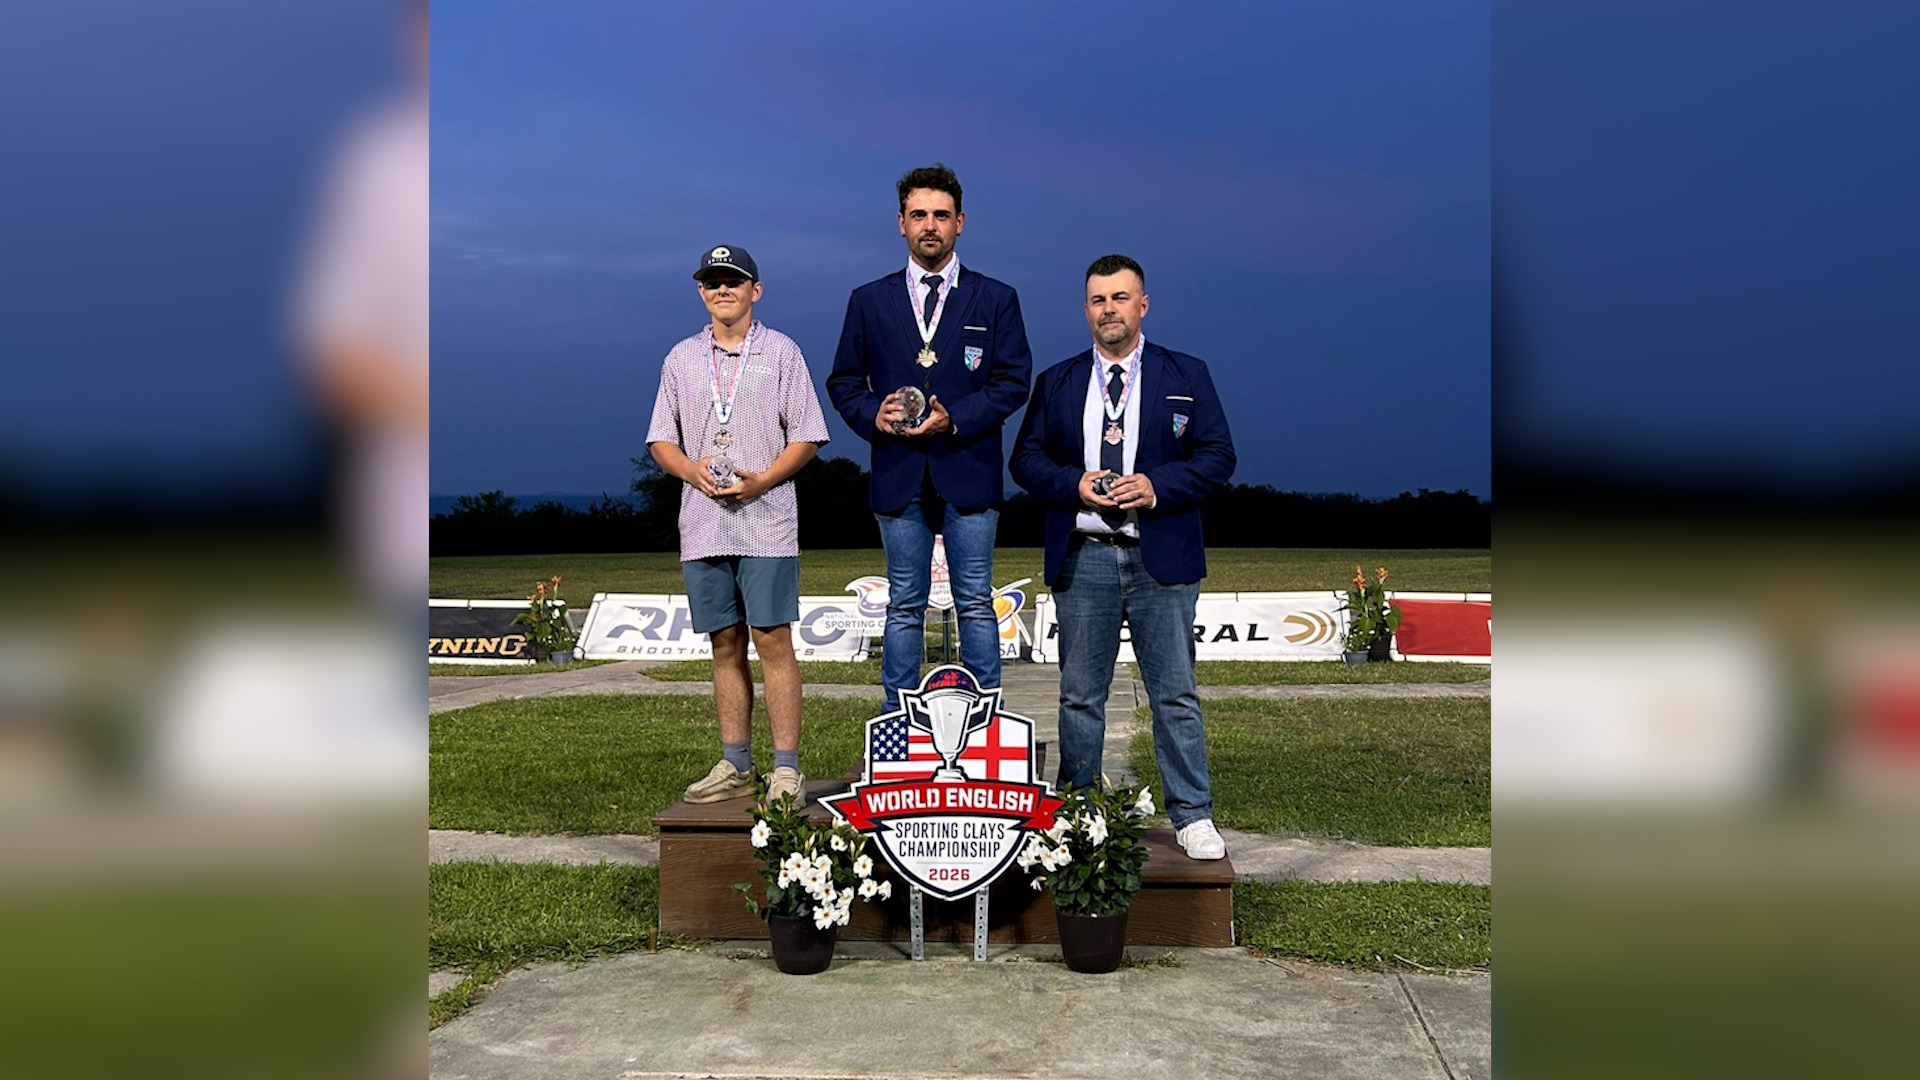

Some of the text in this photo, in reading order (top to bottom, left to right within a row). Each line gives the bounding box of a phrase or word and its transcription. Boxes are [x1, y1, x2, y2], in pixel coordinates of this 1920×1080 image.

[825, 620, 875, 628] SPORTING
[617, 645, 710, 655] SHOOTIN
[999, 643, 1017, 656] SA
[866, 787, 1034, 813] WORLD ENGLISH
[895, 822, 1005, 840] SPORTING CLAYS
[899, 841, 1000, 858] CHAMPIONSHIP
[929, 868, 970, 881] 2026
